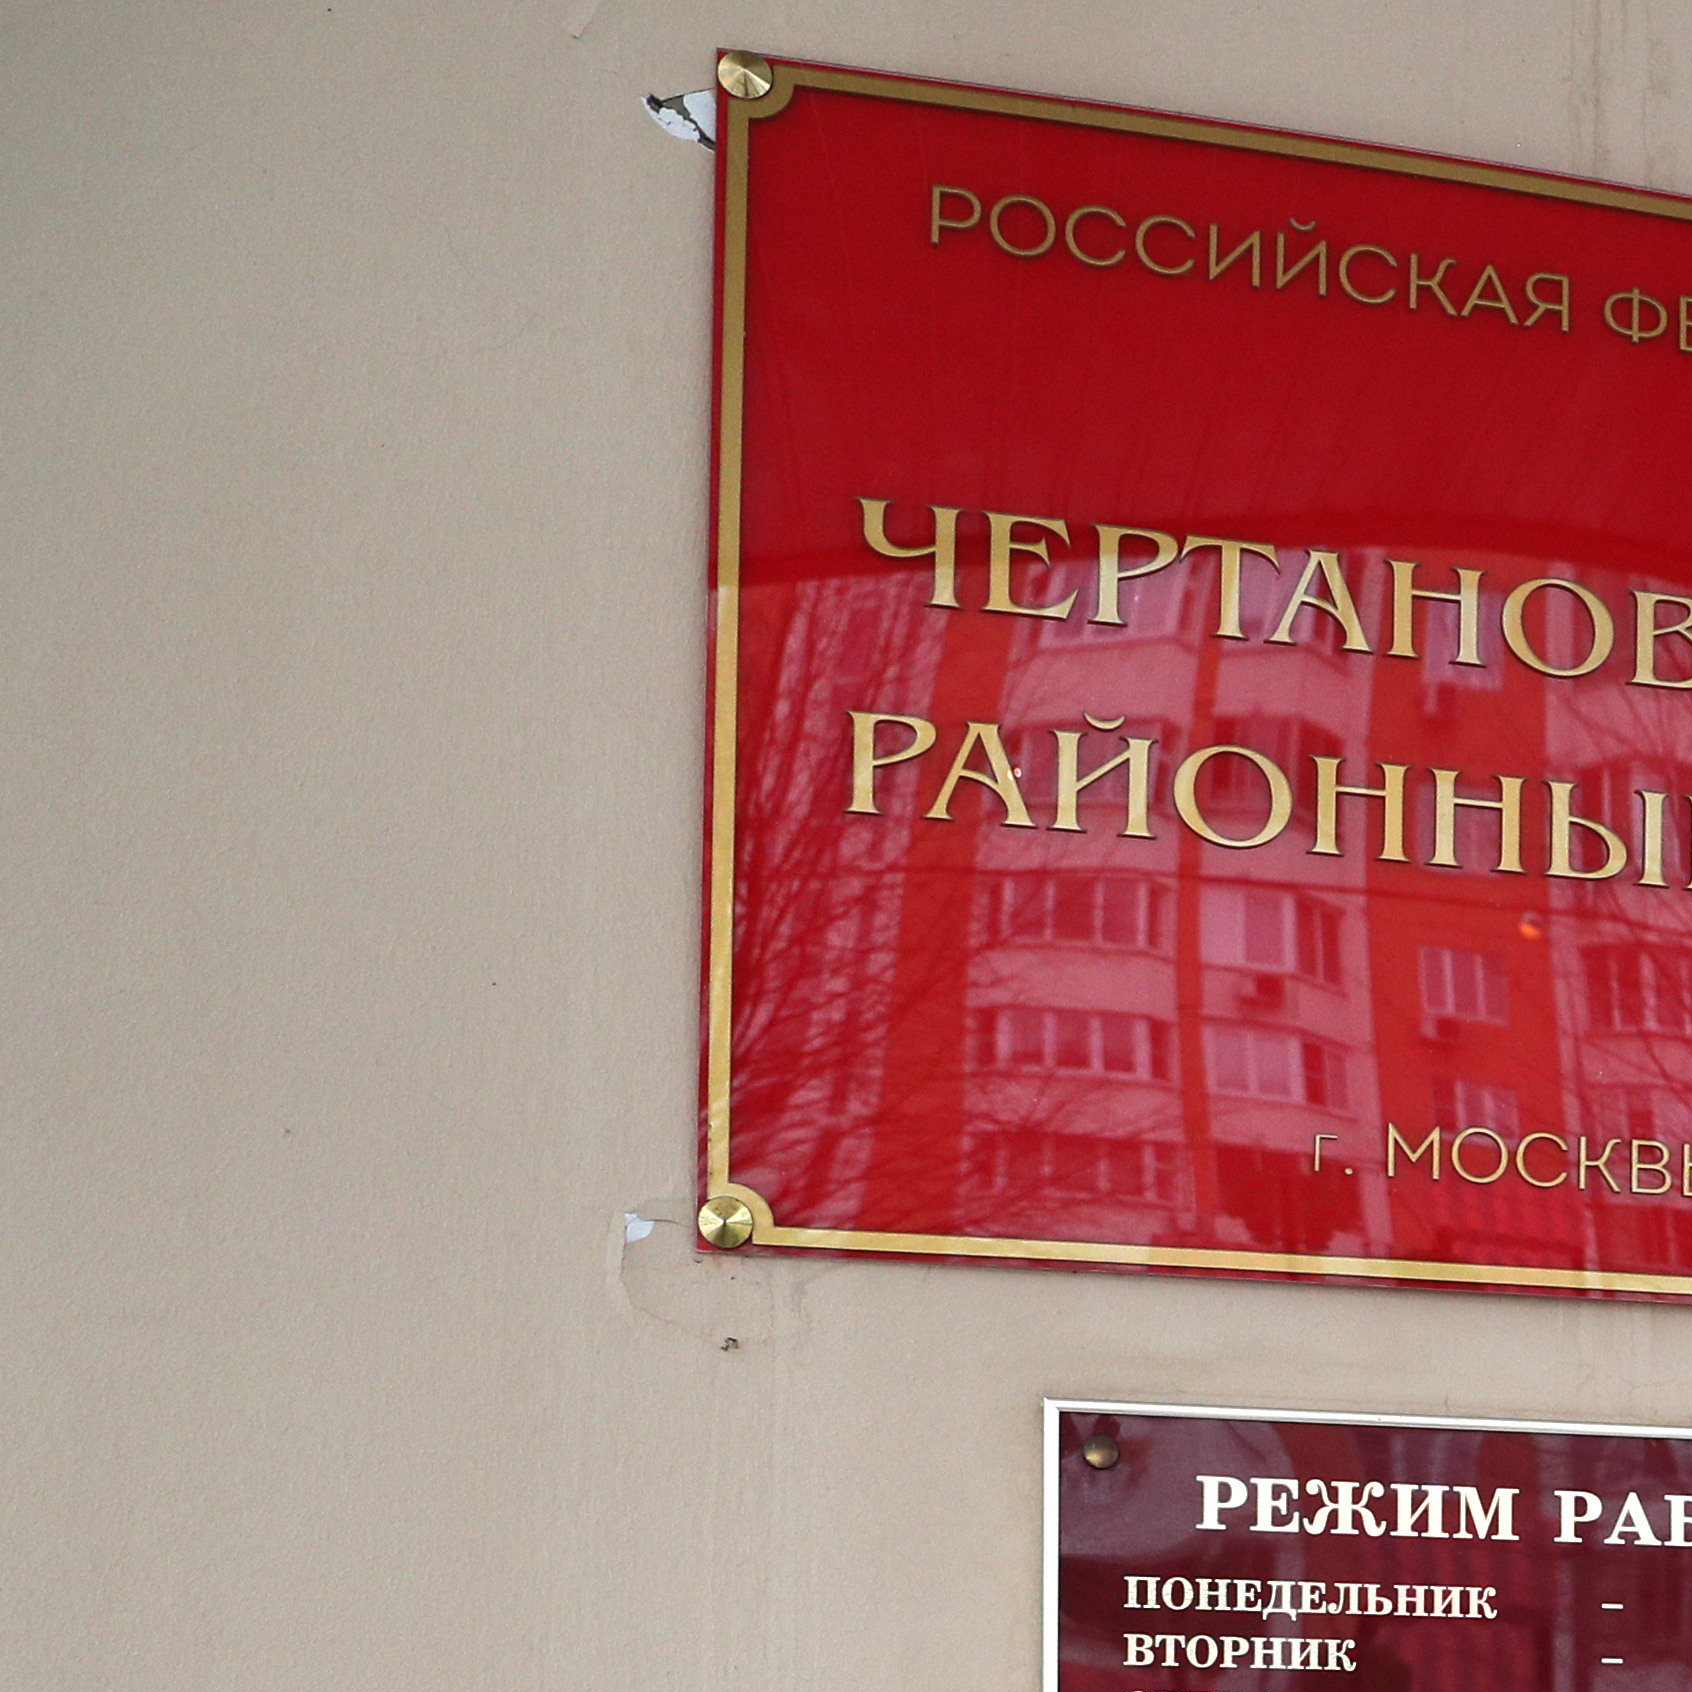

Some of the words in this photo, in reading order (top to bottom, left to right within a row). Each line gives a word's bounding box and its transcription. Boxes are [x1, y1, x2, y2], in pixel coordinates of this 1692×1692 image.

[930, 184, 1570, 333] РОССИЙСКАЯ
[1194, 1474, 1520, 1541] РЕЖИМ
[1123, 1575, 1498, 1622] ПОНЕДЕЛЬНИК
[1122, 1633, 1357, 1672] ВТОРНИК
